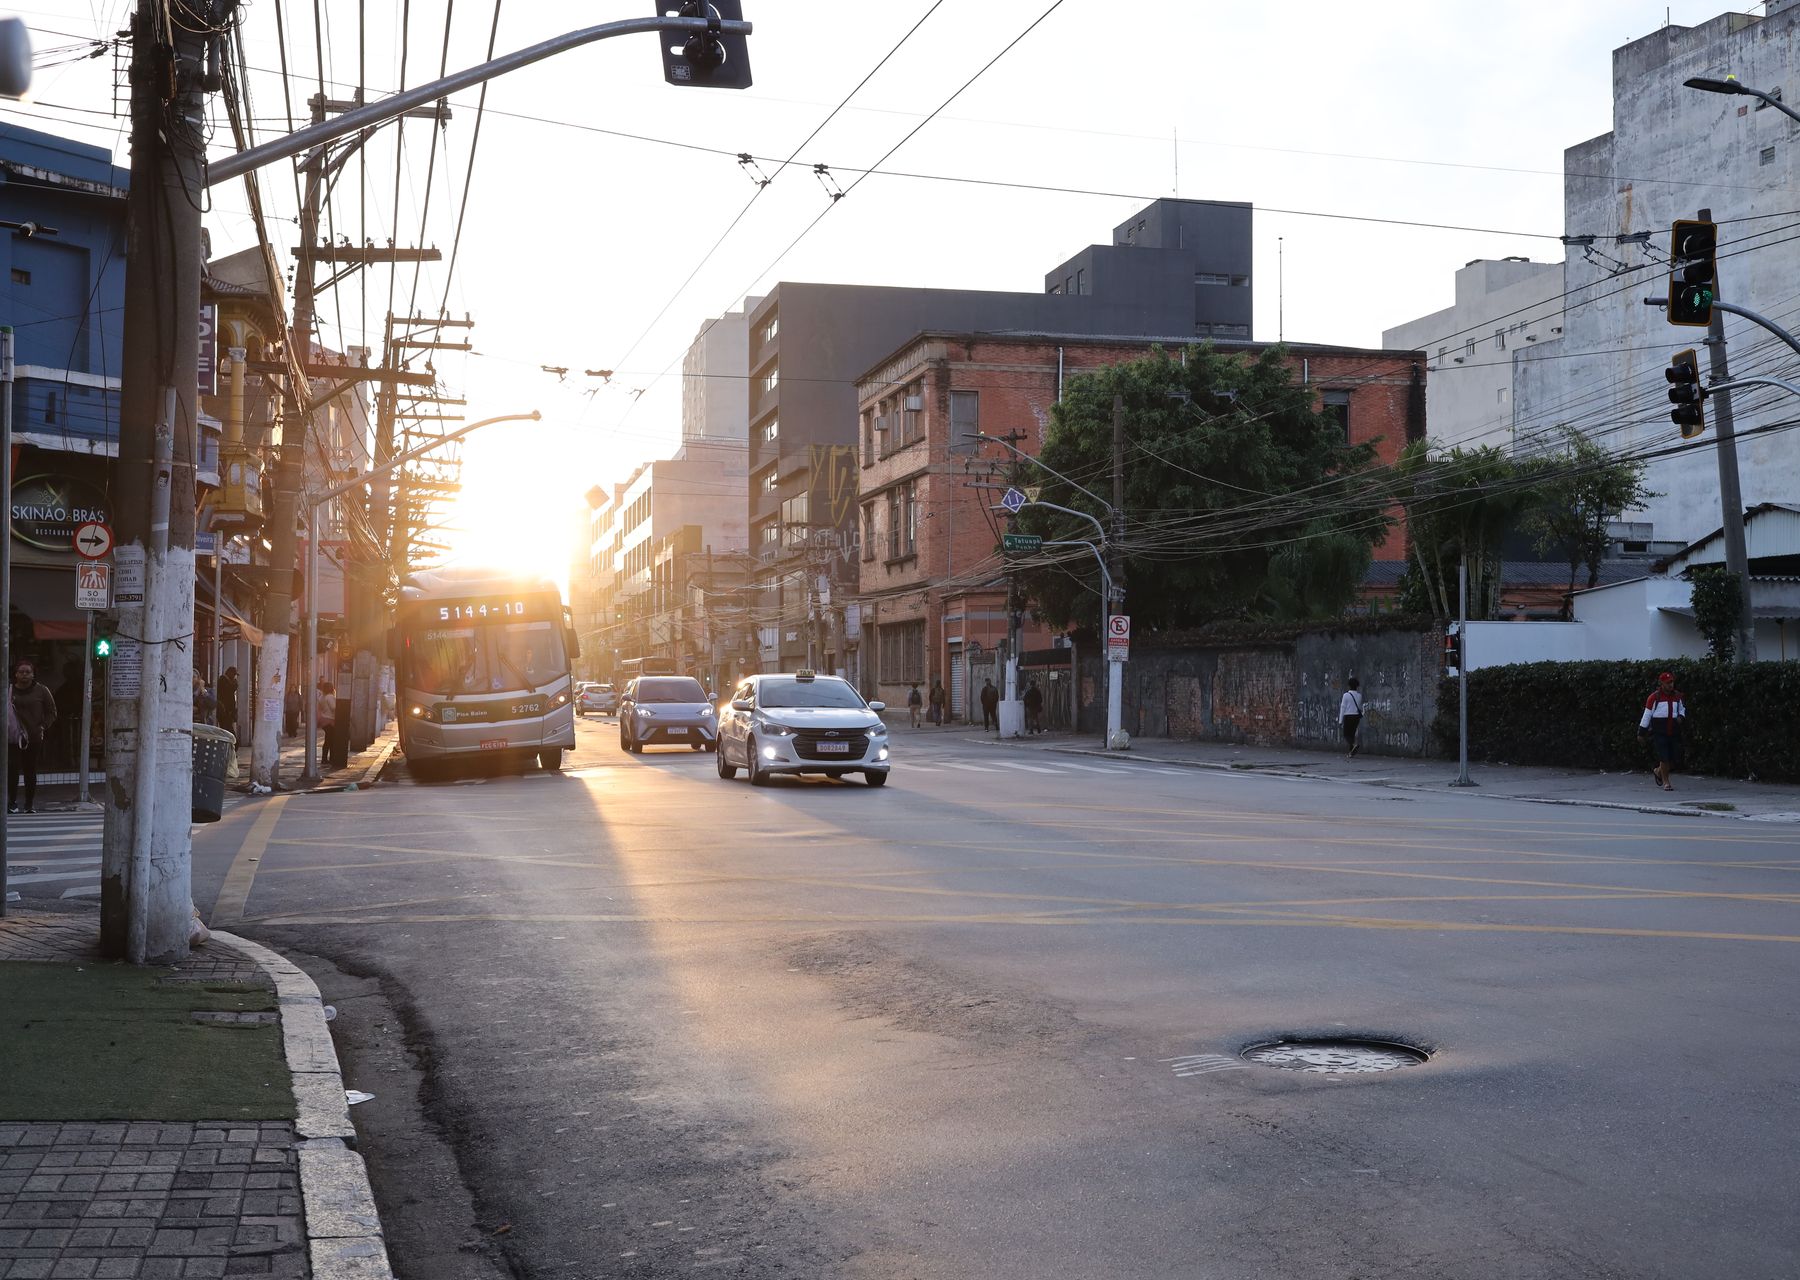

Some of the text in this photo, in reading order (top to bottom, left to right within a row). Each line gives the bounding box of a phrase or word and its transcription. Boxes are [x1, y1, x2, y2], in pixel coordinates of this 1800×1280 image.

[1029, 489, 1037, 498] 20
[11, 504, 66, 522] SKINÃO
[73, 507, 104, 524] BRÁS
[35, 528, 74, 536] RESTAURAN
[440, 602, 524, 620] 5144-10
[518, 703, 540, 713] 2762
